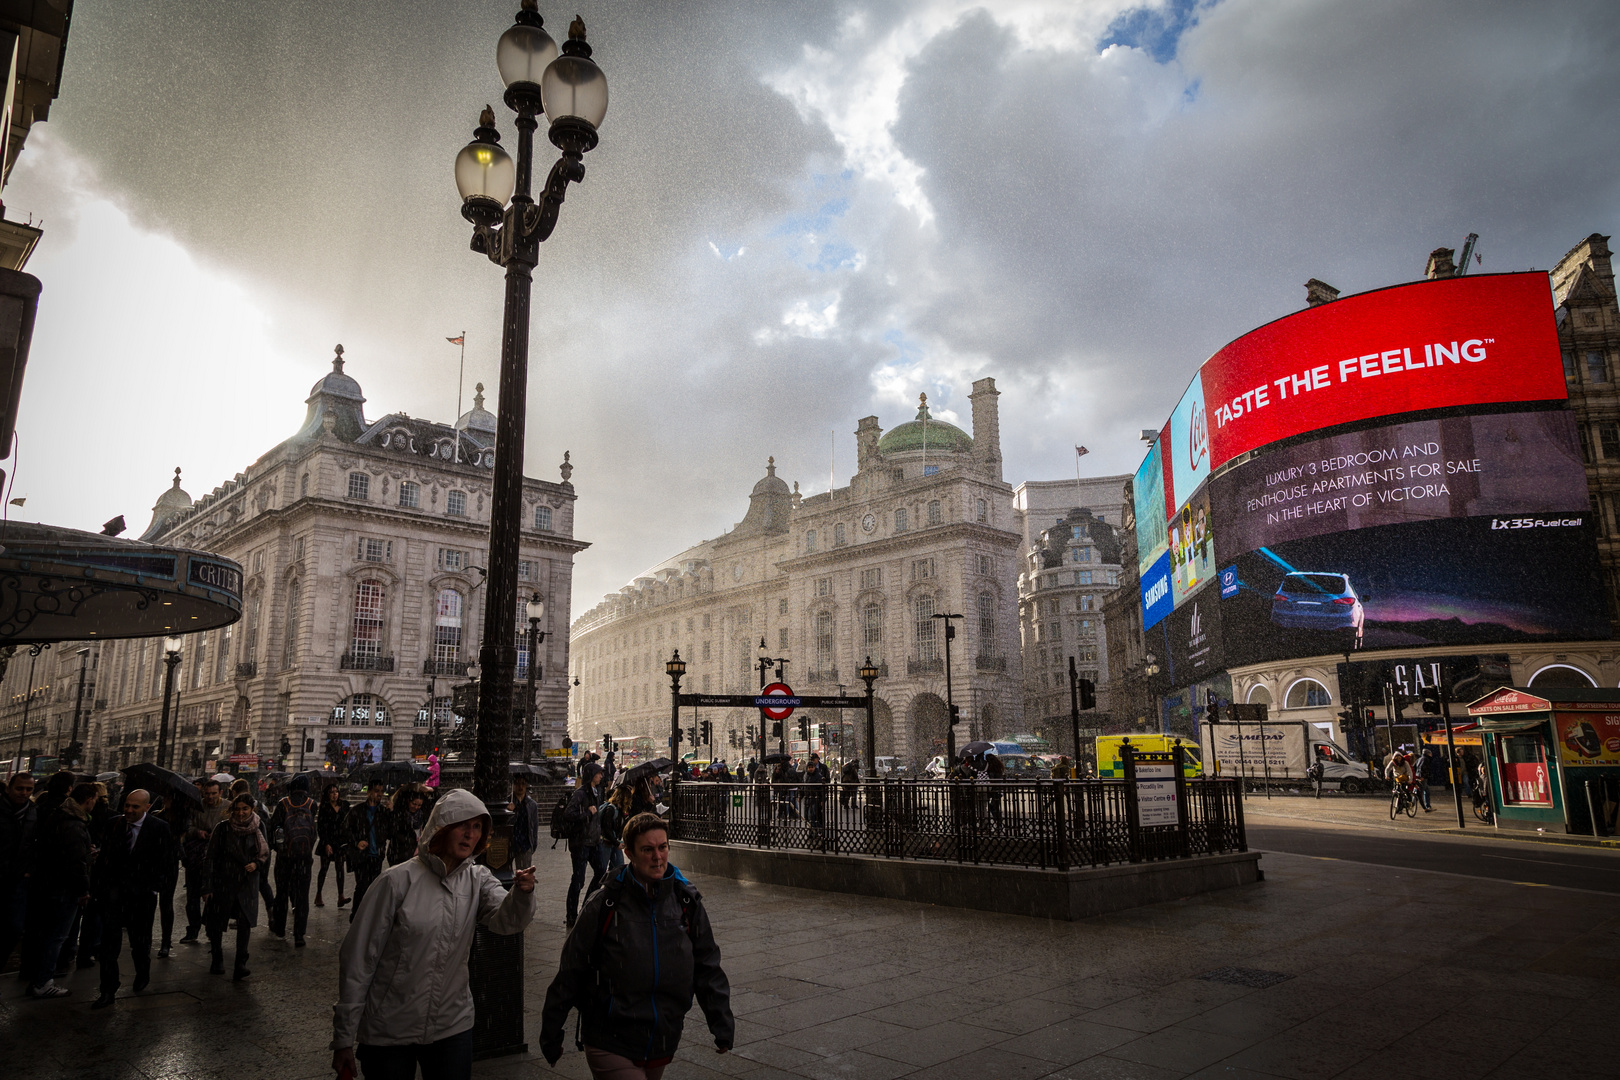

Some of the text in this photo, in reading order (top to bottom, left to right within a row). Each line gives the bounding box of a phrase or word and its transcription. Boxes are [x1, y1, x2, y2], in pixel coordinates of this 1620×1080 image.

[1214, 384, 1270, 428] TASTE
[1274, 364, 1331, 400] THE
[1265, 442, 1440, 486] LUXURY 3 BEDROOM AND
[1247, 459, 1482, 512] PENTHOUSE APARTMENTS FOR SALE
[1267, 483, 1451, 525] IN THE HEART OF VICTORIA
[1491, 518, 1582, 530] ix35 Fuel Cell
[1145, 574, 1168, 610] SAMSUNG
[356, 708, 384, 722] Stig
[1605, 715, 1620, 726] SIG
